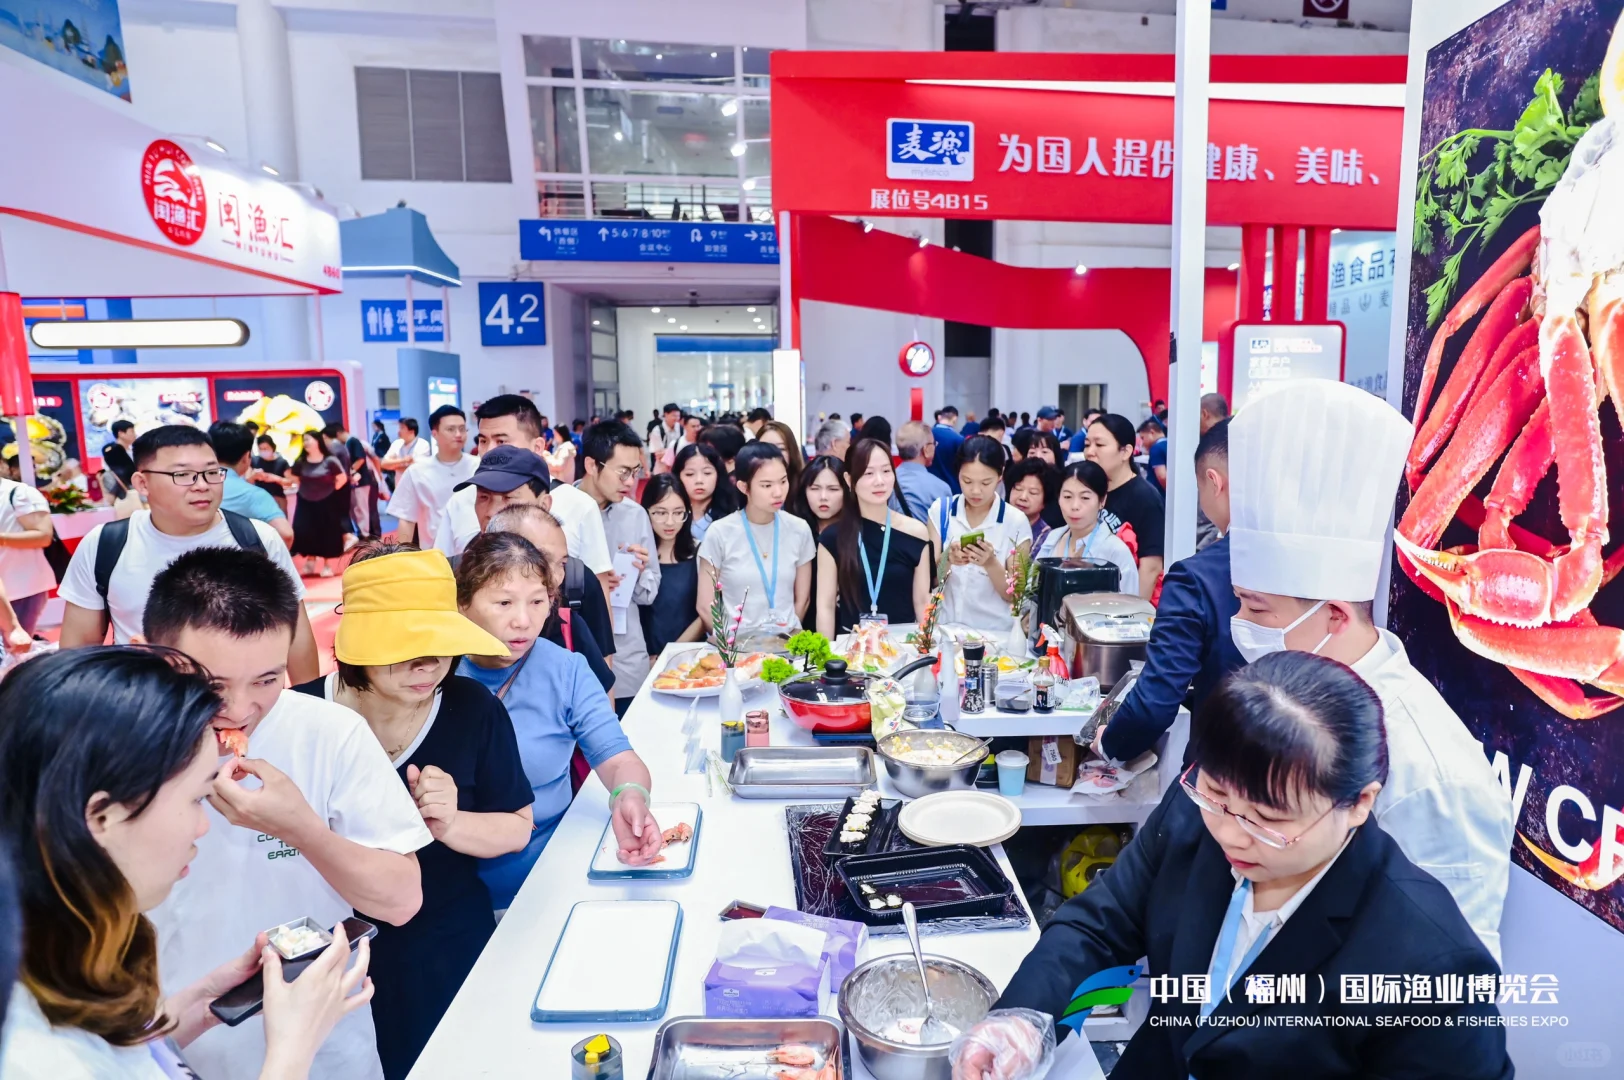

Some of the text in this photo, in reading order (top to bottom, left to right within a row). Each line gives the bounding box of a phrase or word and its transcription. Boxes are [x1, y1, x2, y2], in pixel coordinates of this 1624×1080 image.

[153, 197, 202, 232] 闽渔汇
[870, 188, 988, 210] 展位号4B15
[218, 192, 294, 249] 闽渔汇
[396, 309, 444, 324] 洗手间
[485, 293, 540, 335] 4.2
